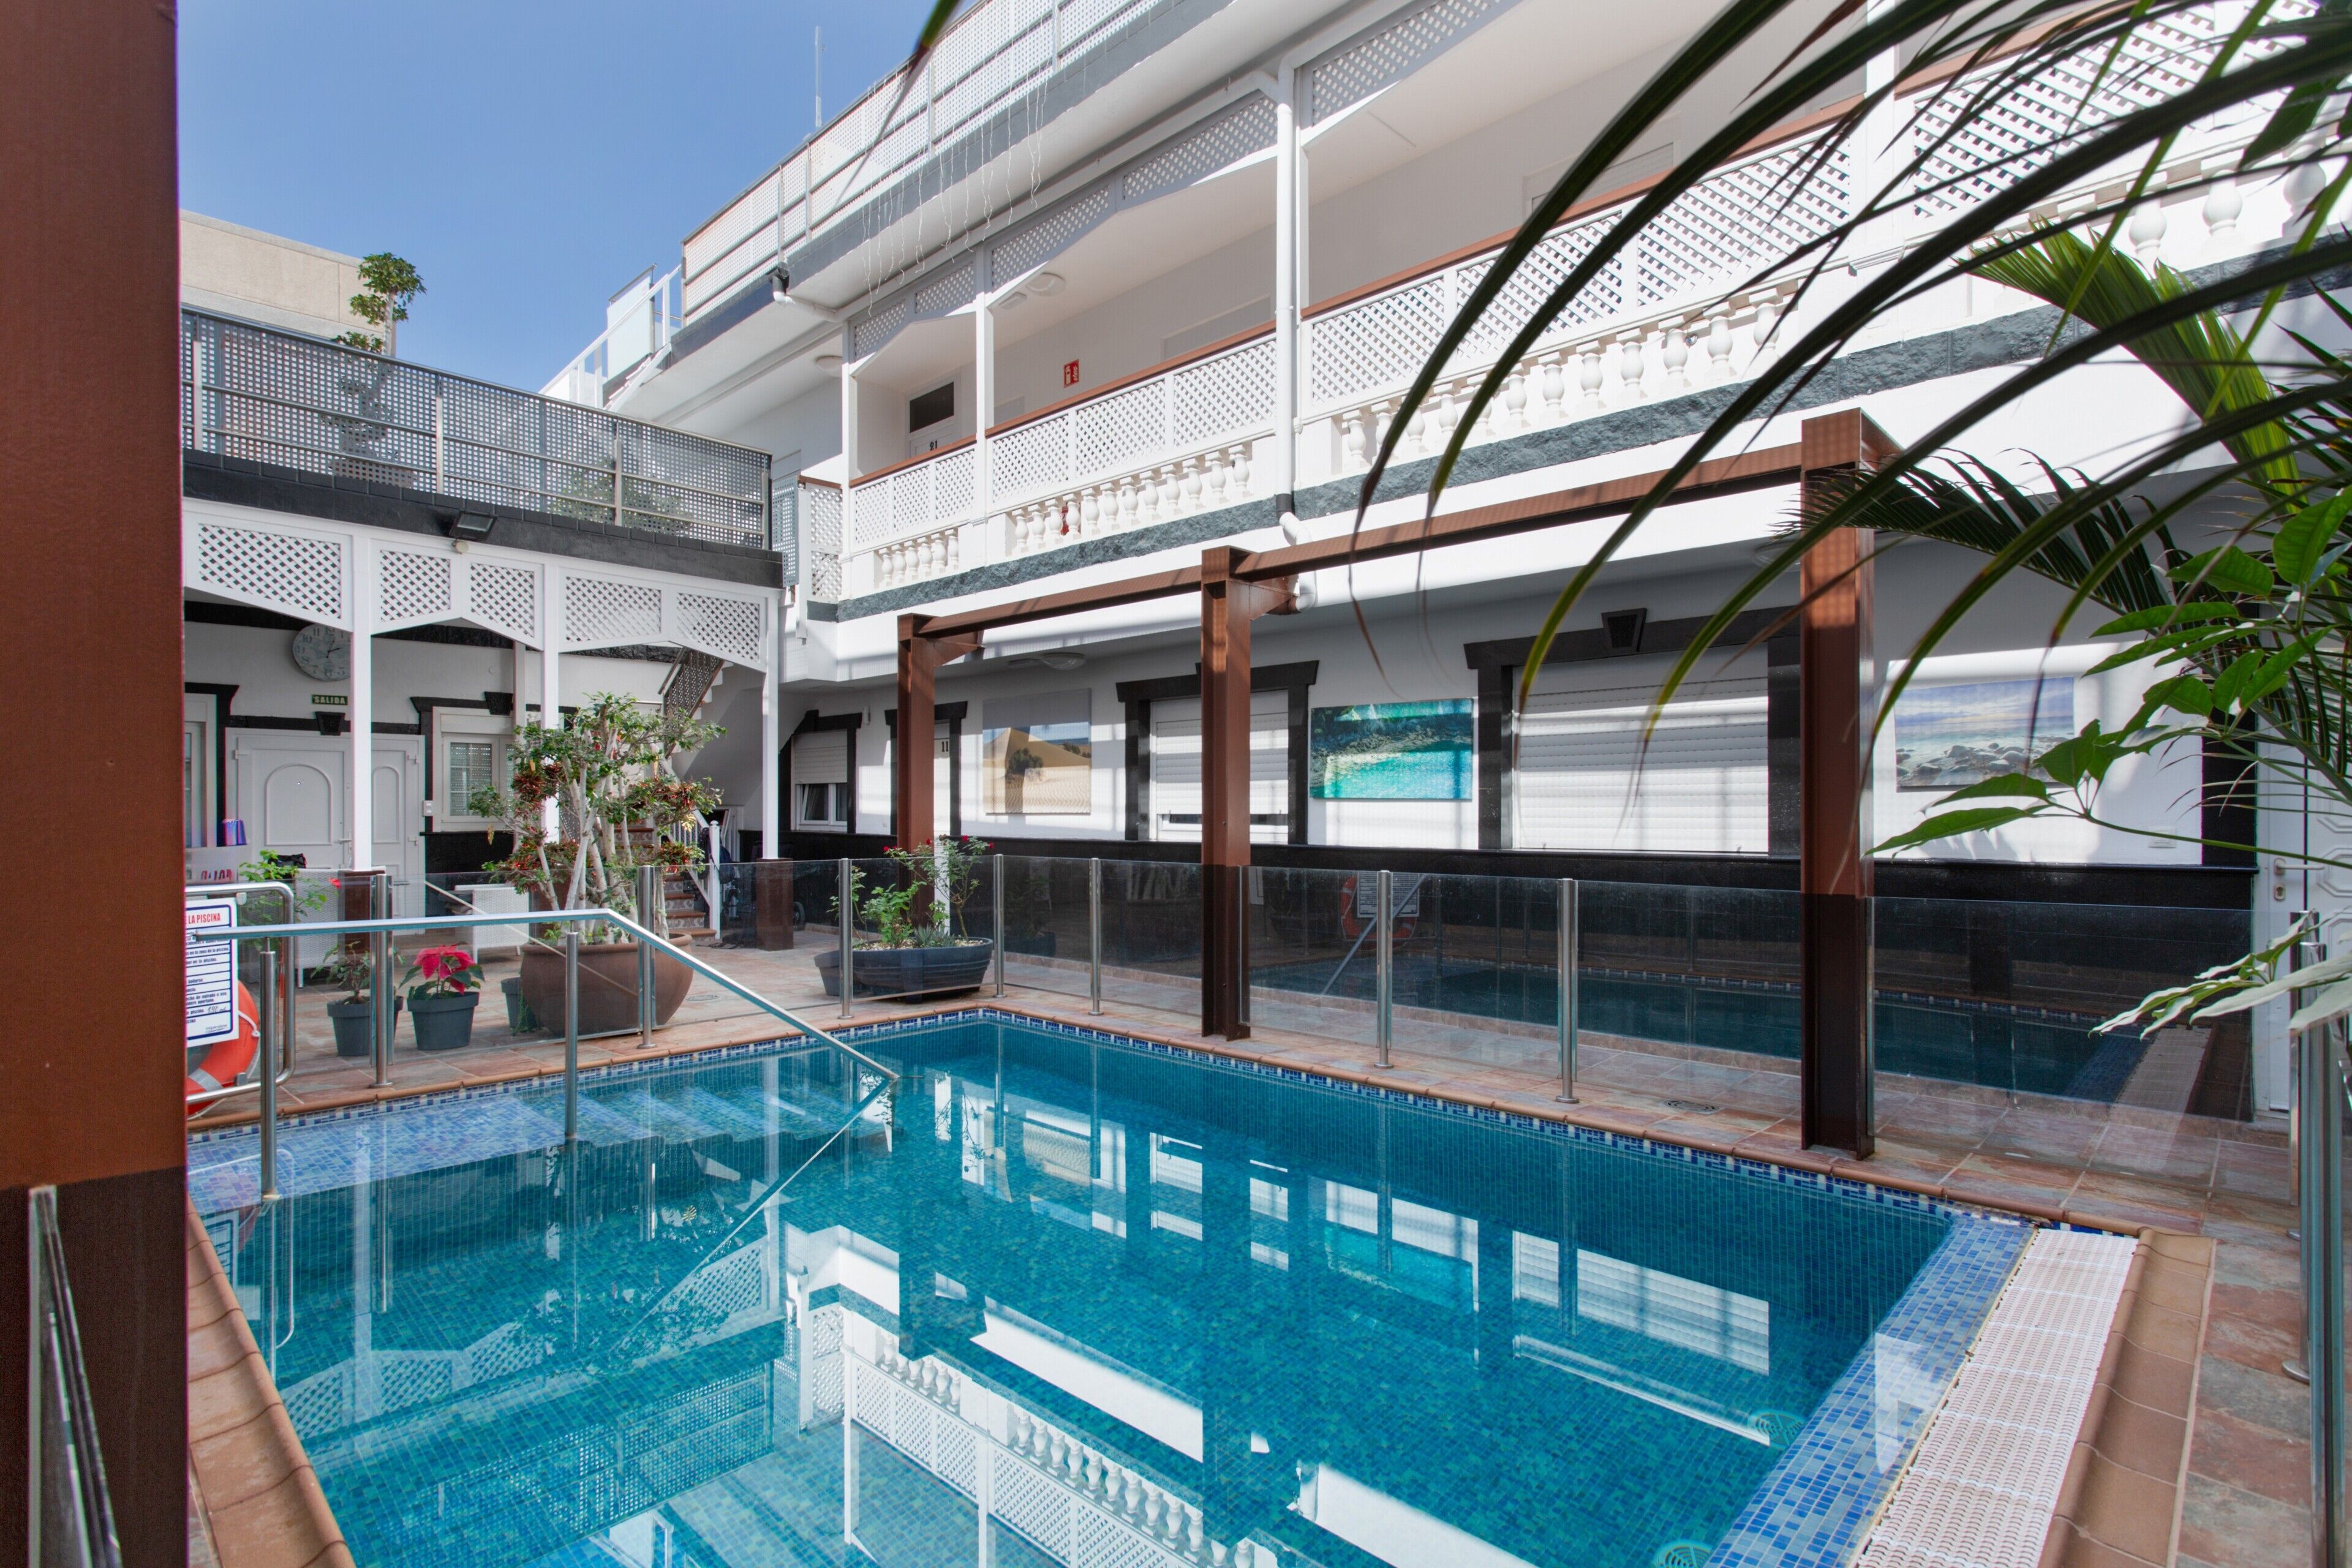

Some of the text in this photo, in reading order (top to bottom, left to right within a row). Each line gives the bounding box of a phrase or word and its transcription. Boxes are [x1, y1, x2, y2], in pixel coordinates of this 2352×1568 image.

[313, 627, 320, 636] 11
[303, 634, 312, 644] 10
[314, 696, 345, 704] SALIDA
[941, 741, 949, 752] 11
[188, 913, 221, 924] LA PISCINA
